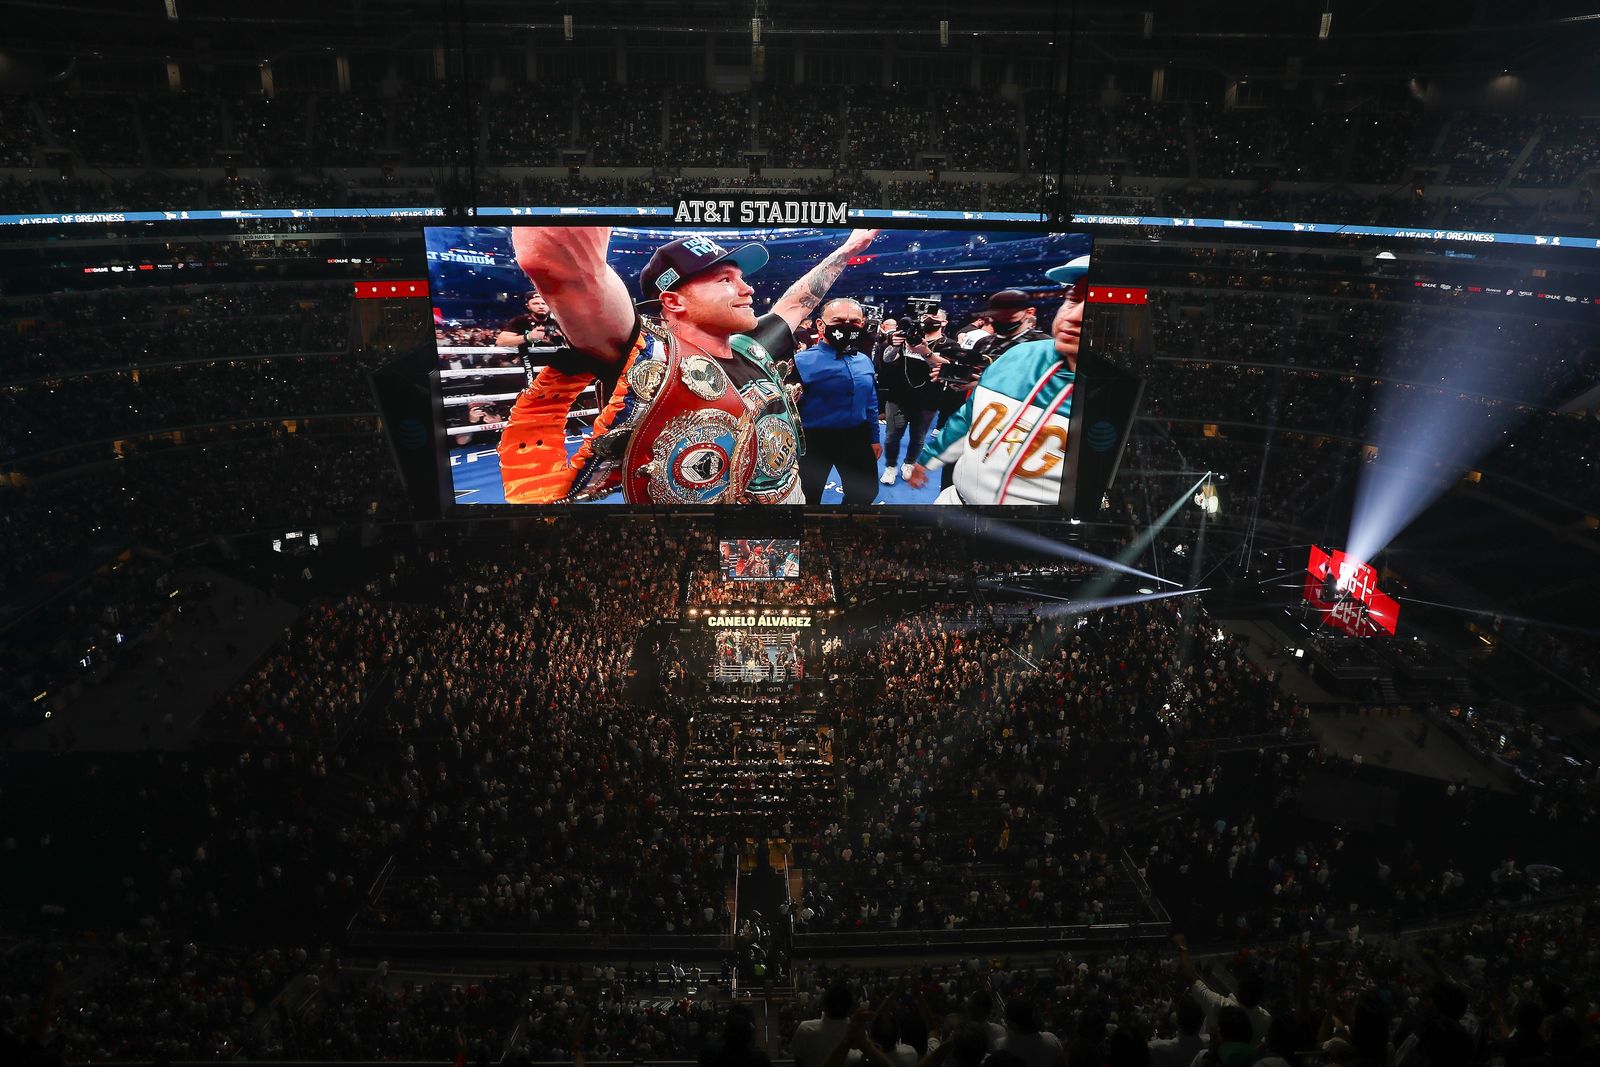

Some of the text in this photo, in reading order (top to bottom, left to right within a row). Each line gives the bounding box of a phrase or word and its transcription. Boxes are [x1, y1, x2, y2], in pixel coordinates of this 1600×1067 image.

[425, 209, 434, 217] OF
[674, 200, 848, 224] AT&T STADIUM
[62, 215, 73, 223] OF
[75, 213, 125, 223] GREATNESS
[1098, 216, 1140, 225] GREATNESS
[1434, 231, 1446, 239] OF
[1446, 231, 1495, 242] GREATNESS
[440, 252, 496, 265] STADIUM
[707, 614, 812, 627] CANELO ÁLVAREZ
